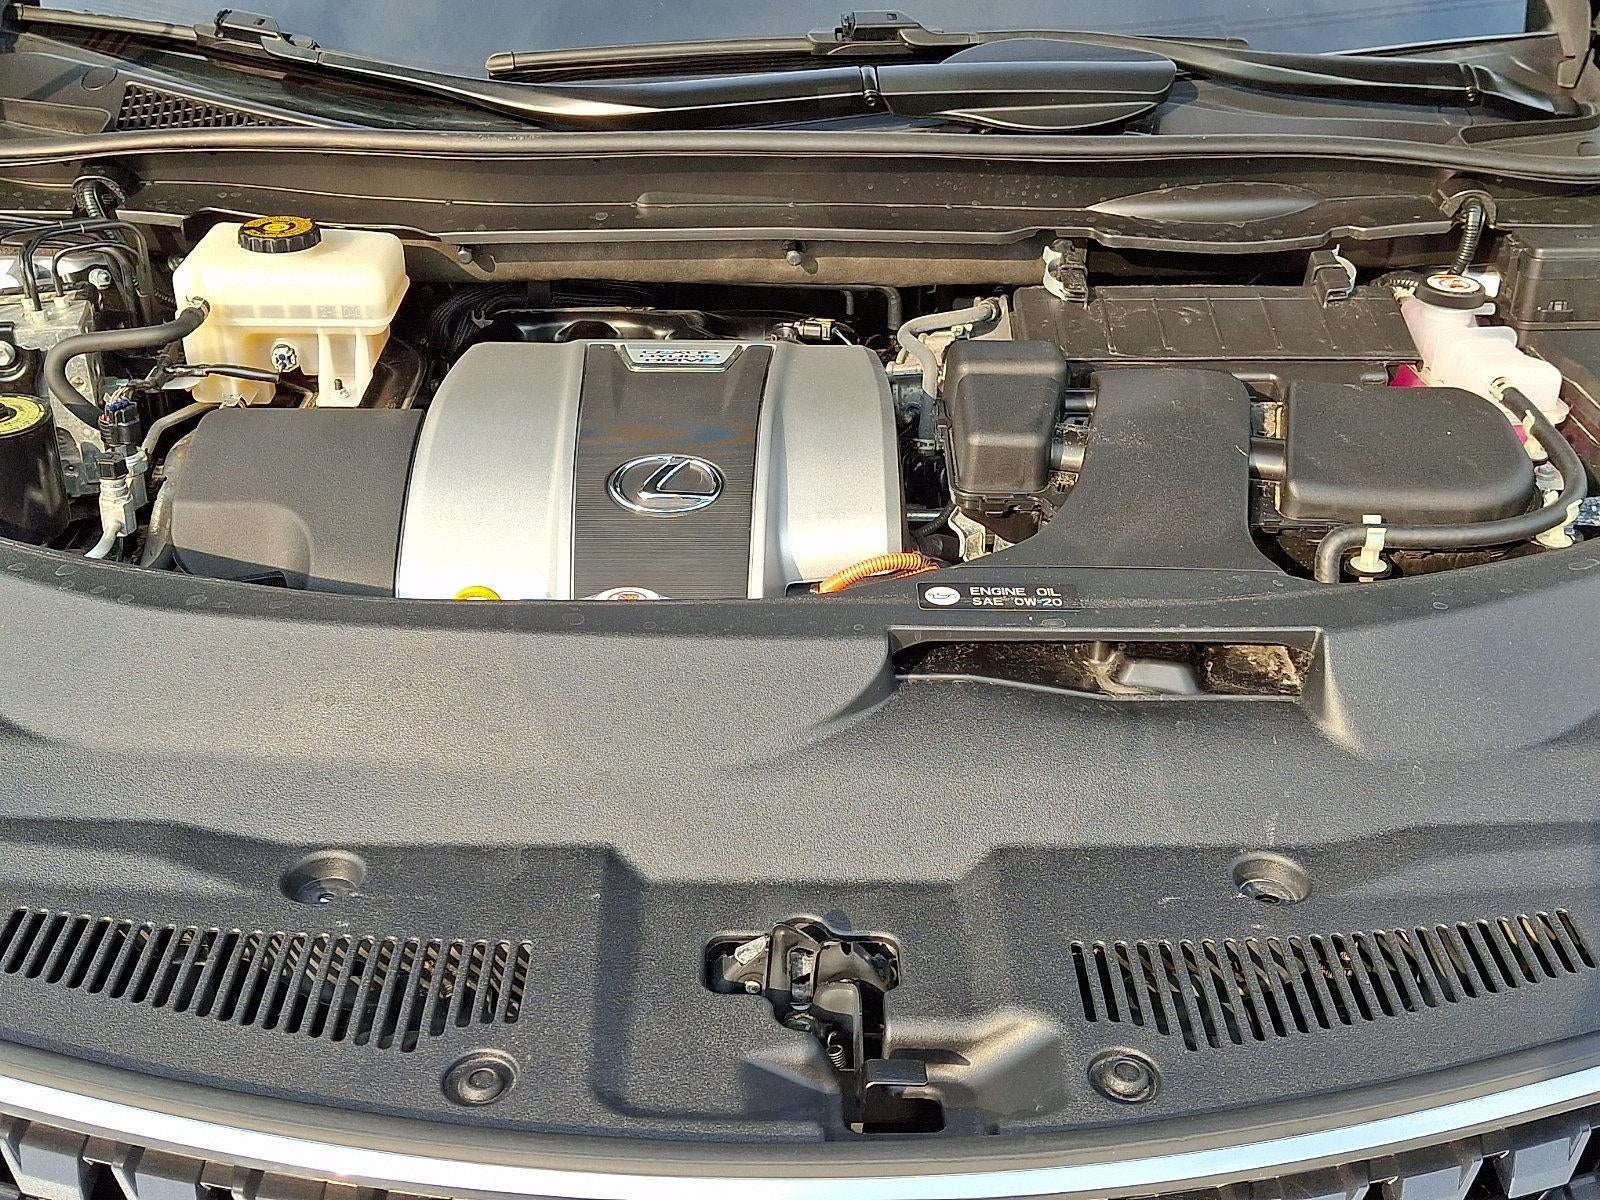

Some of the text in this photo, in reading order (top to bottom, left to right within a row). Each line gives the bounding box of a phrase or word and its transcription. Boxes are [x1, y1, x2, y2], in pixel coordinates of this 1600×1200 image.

[969, 587, 1062, 596] ENGINE OIL
[972, 597, 1062, 607] SAE 0W-20
